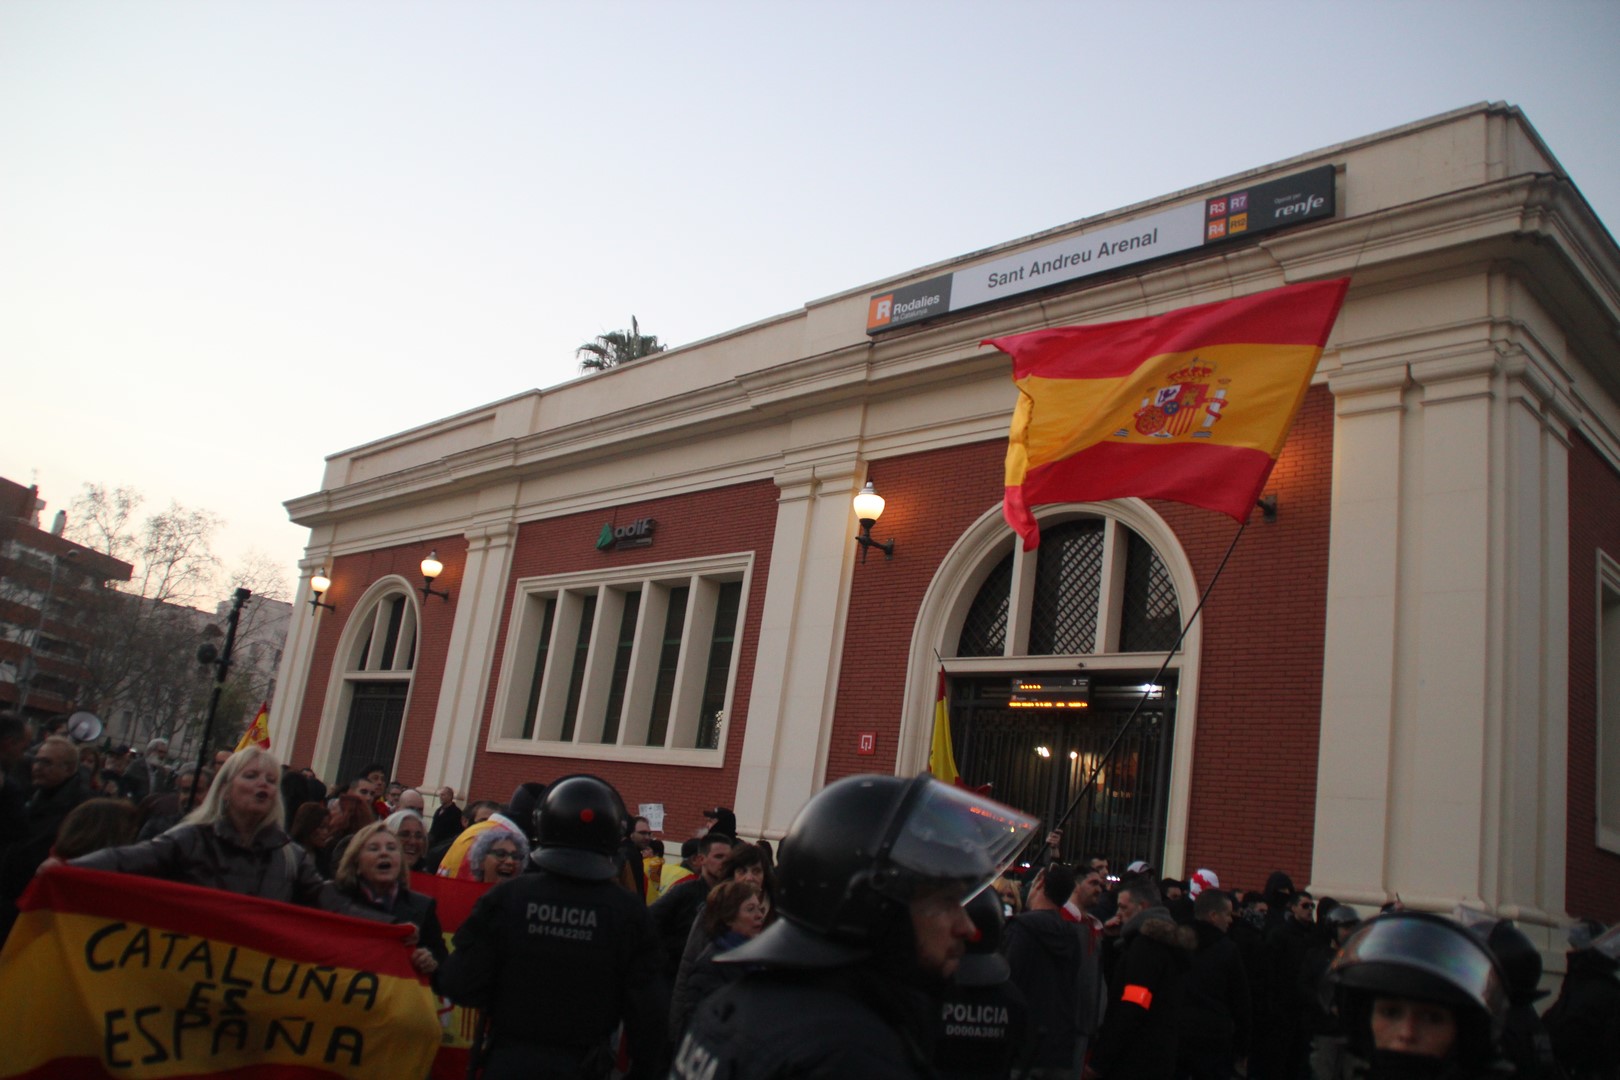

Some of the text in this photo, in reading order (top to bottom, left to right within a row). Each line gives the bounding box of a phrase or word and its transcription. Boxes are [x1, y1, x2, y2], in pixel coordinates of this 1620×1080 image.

[1209, 202, 1225, 215] R3
[1230, 196, 1247, 209] R7
[1274, 194, 1324, 218] renfe
[1208, 223, 1224, 236] R4
[987, 228, 1158, 288] Sant Andreu Arenal
[876, 300, 891, 320] R
[893, 294, 940, 315] Rodalies
[526, 902, 597, 927] POLICIA
[85, 922, 380, 1011] CATALUÑA
[186, 981, 249, 1016] ES
[942, 1003, 1009, 1024] POLICIA
[105, 1006, 364, 1068] ESPAÑA
